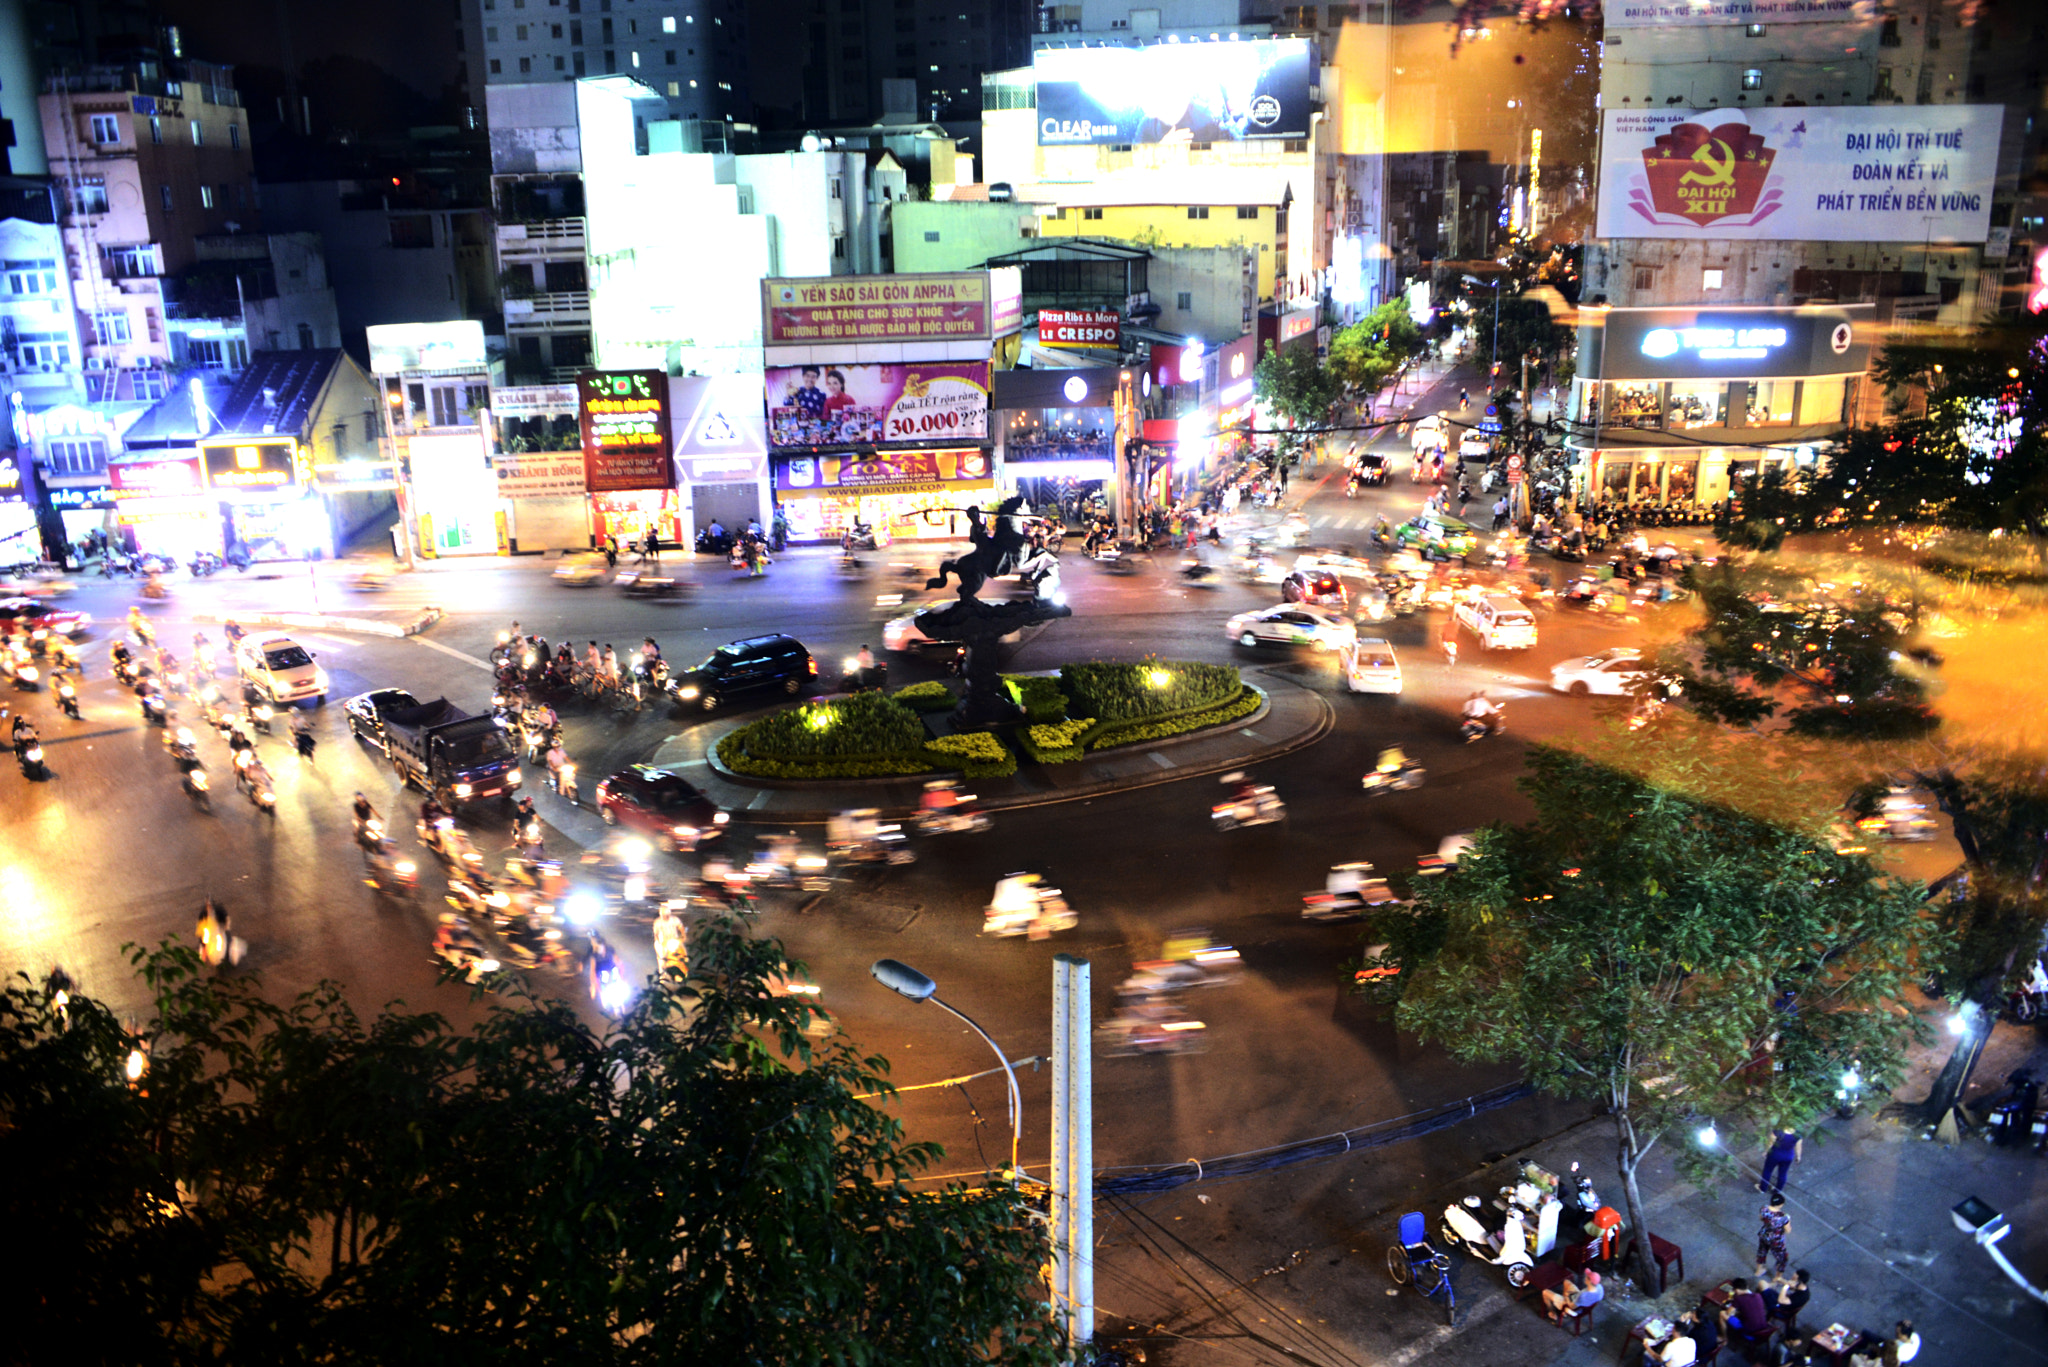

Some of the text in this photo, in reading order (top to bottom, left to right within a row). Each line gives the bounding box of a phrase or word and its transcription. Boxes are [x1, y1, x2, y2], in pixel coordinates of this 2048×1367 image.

[1041, 117, 1092, 137] CLEAR
[1616, 115, 1685, 124] ĐẢNG CỘNG SẢN
[1616, 125, 1633, 133] VIỆT
[1846, 128, 1963, 154] ĐẠI HỘI TRÍ TUỆ
[1852, 156, 1949, 180] ĐOÀN KẾT VÀ
[1677, 185, 1736, 200] ĐẠI HỘI
[1817, 185, 1982, 212] PHÁT TRIỂN BỀN VỮNG
[1684, 200, 1728, 214] XII
[800, 282, 955, 302] YẾN SÀO SÀI GÒN ANPHA
[811, 307, 834, 322] QUÀ
[836, 307, 864, 321] TẶNG
[867, 308, 889, 319] CHO
[892, 305, 914, 318] SỨC
[1039, 311, 1118, 323] Pizza Ribs & More
[821, 323, 843, 337] HIỆU
[908, 320, 921, 335] HỘ
[923, 319, 942, 335] ĐỘC
[1041, 327, 1116, 341] LE CRESPO
[897, 399, 916, 412] Quà
[919, 392, 939, 408] TẾT
[958, 391, 979, 401] ràng
[889, 411, 959, 436] 30.000
[509, 463, 582, 479] KHÁNH HỒNG
[827, 483, 947, 496] WWW.BIATOYEN.COM
[842, 477, 936, 487] WWW.BIATOYEN.COM
